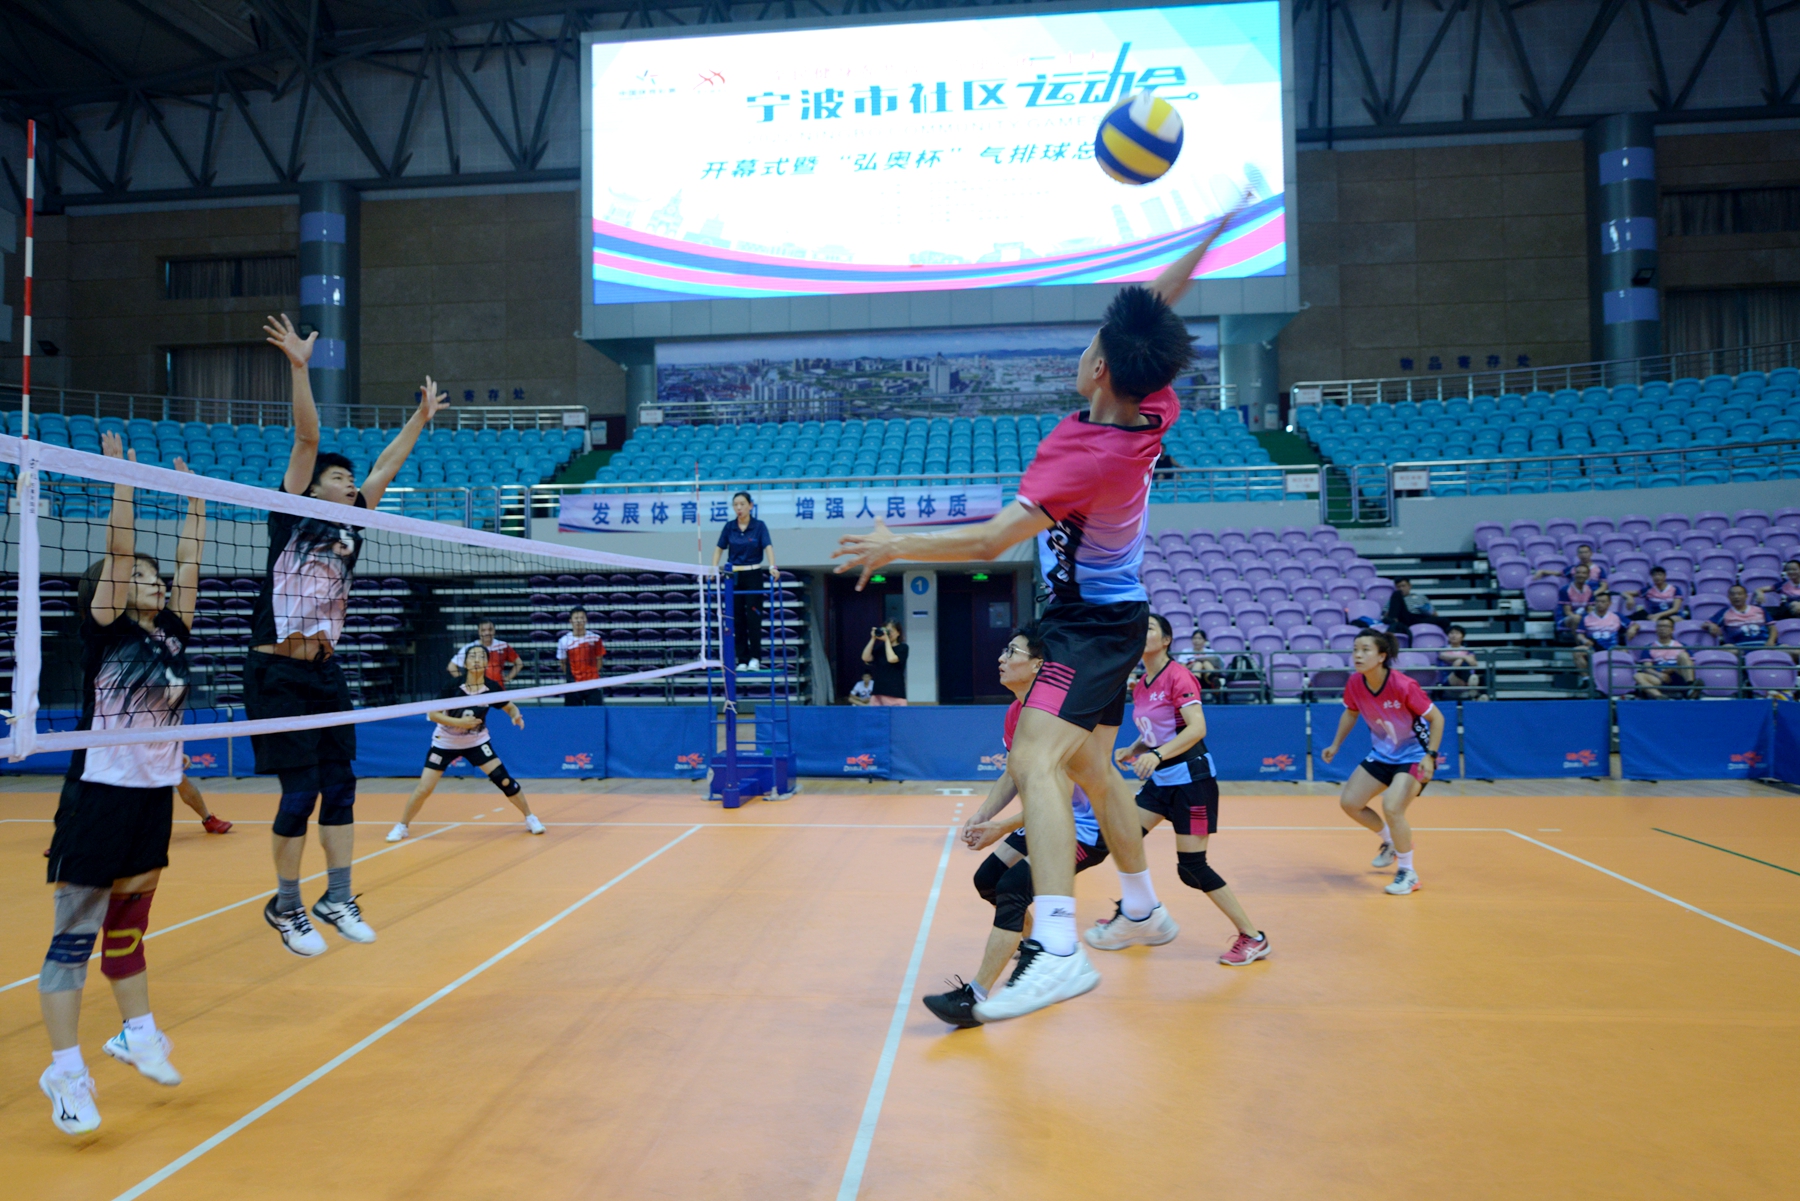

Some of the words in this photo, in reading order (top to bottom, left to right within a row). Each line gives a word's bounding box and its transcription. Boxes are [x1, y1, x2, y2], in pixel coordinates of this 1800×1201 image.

[747, 42, 1198, 123] 宁波市社区运动会
[700, 155, 819, 180] 开幕式暨
[980, 140, 1095, 165] 气排球总
[795, 493, 968, 520] 增强人民体质
[915, 579, 923, 592] 1
[480, 743, 493, 757] 8
